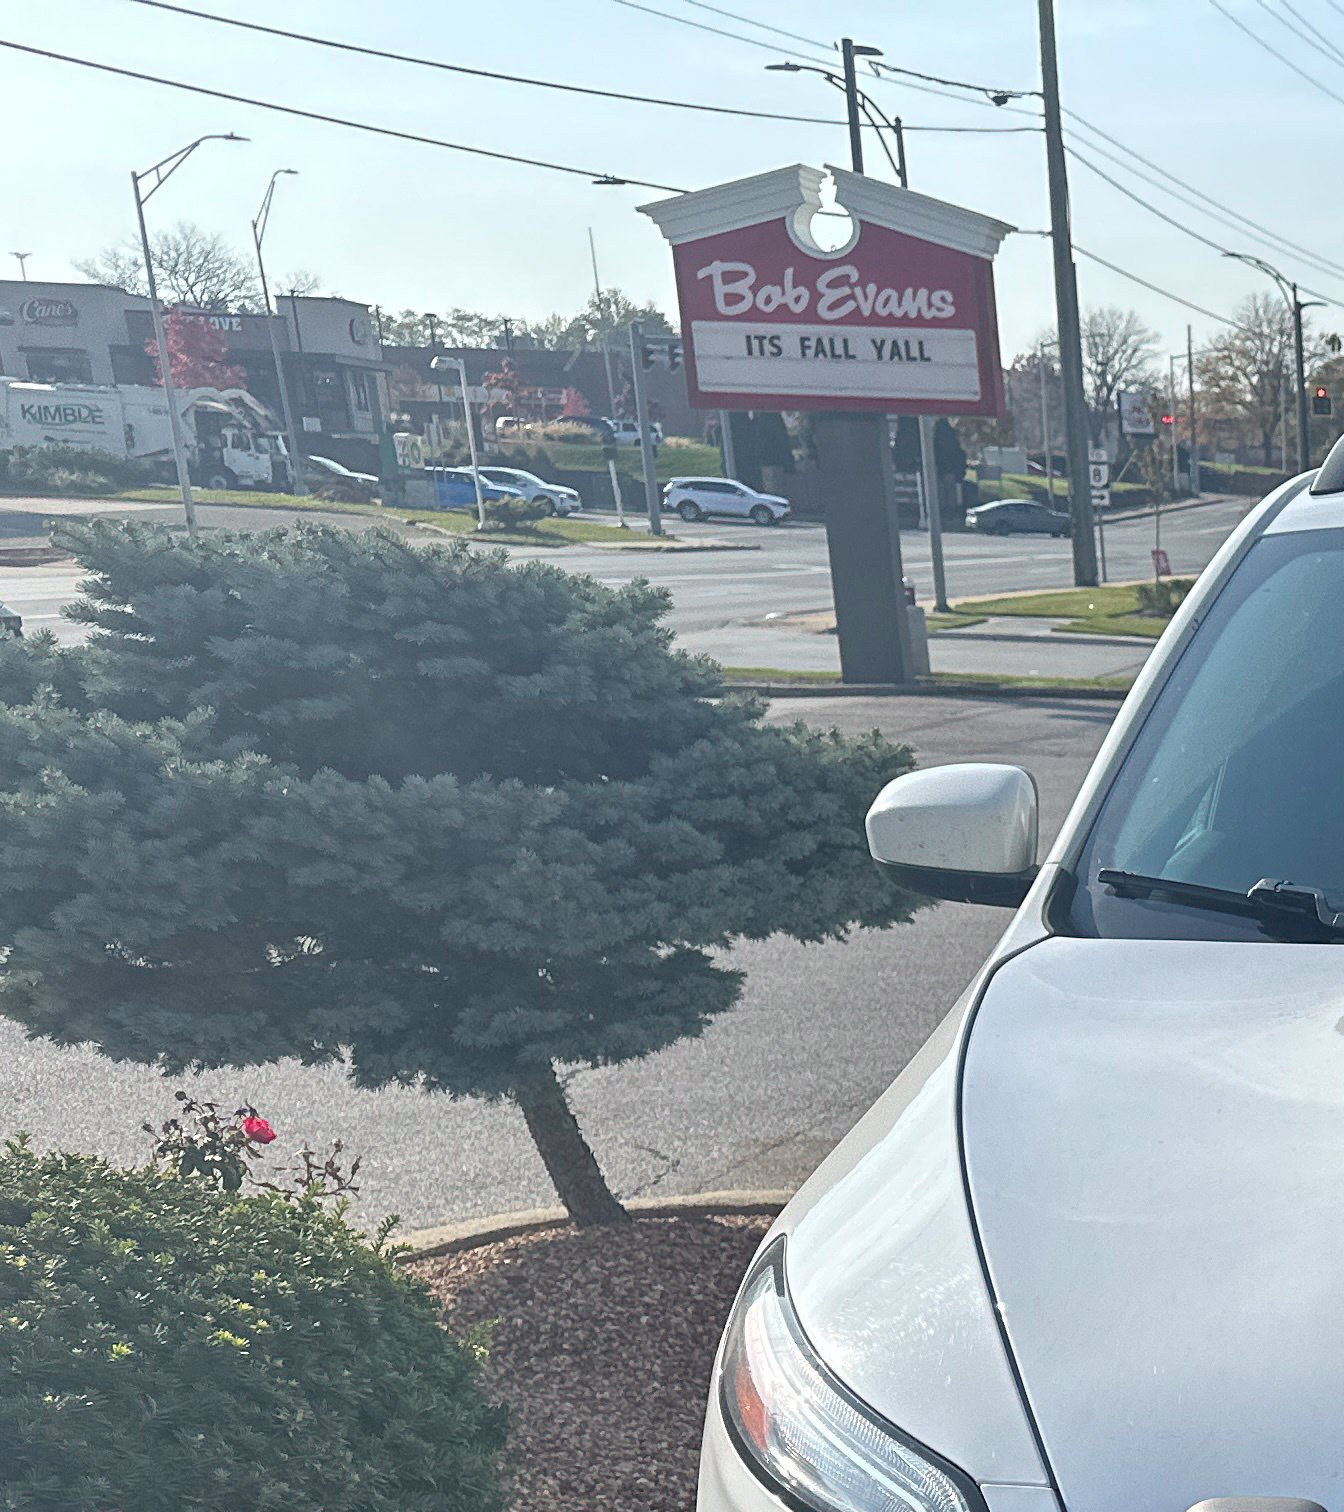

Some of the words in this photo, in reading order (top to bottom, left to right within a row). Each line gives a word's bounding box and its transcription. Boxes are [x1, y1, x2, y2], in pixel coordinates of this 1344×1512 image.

[696, 260, 810, 316] Bob
[816, 265, 955, 321] Evans
[745, 335, 783, 358] ITS
[800, 336, 857, 360] FALL
[870, 338, 932, 362] YALL
[20, 403, 105, 425] KIMBLE
